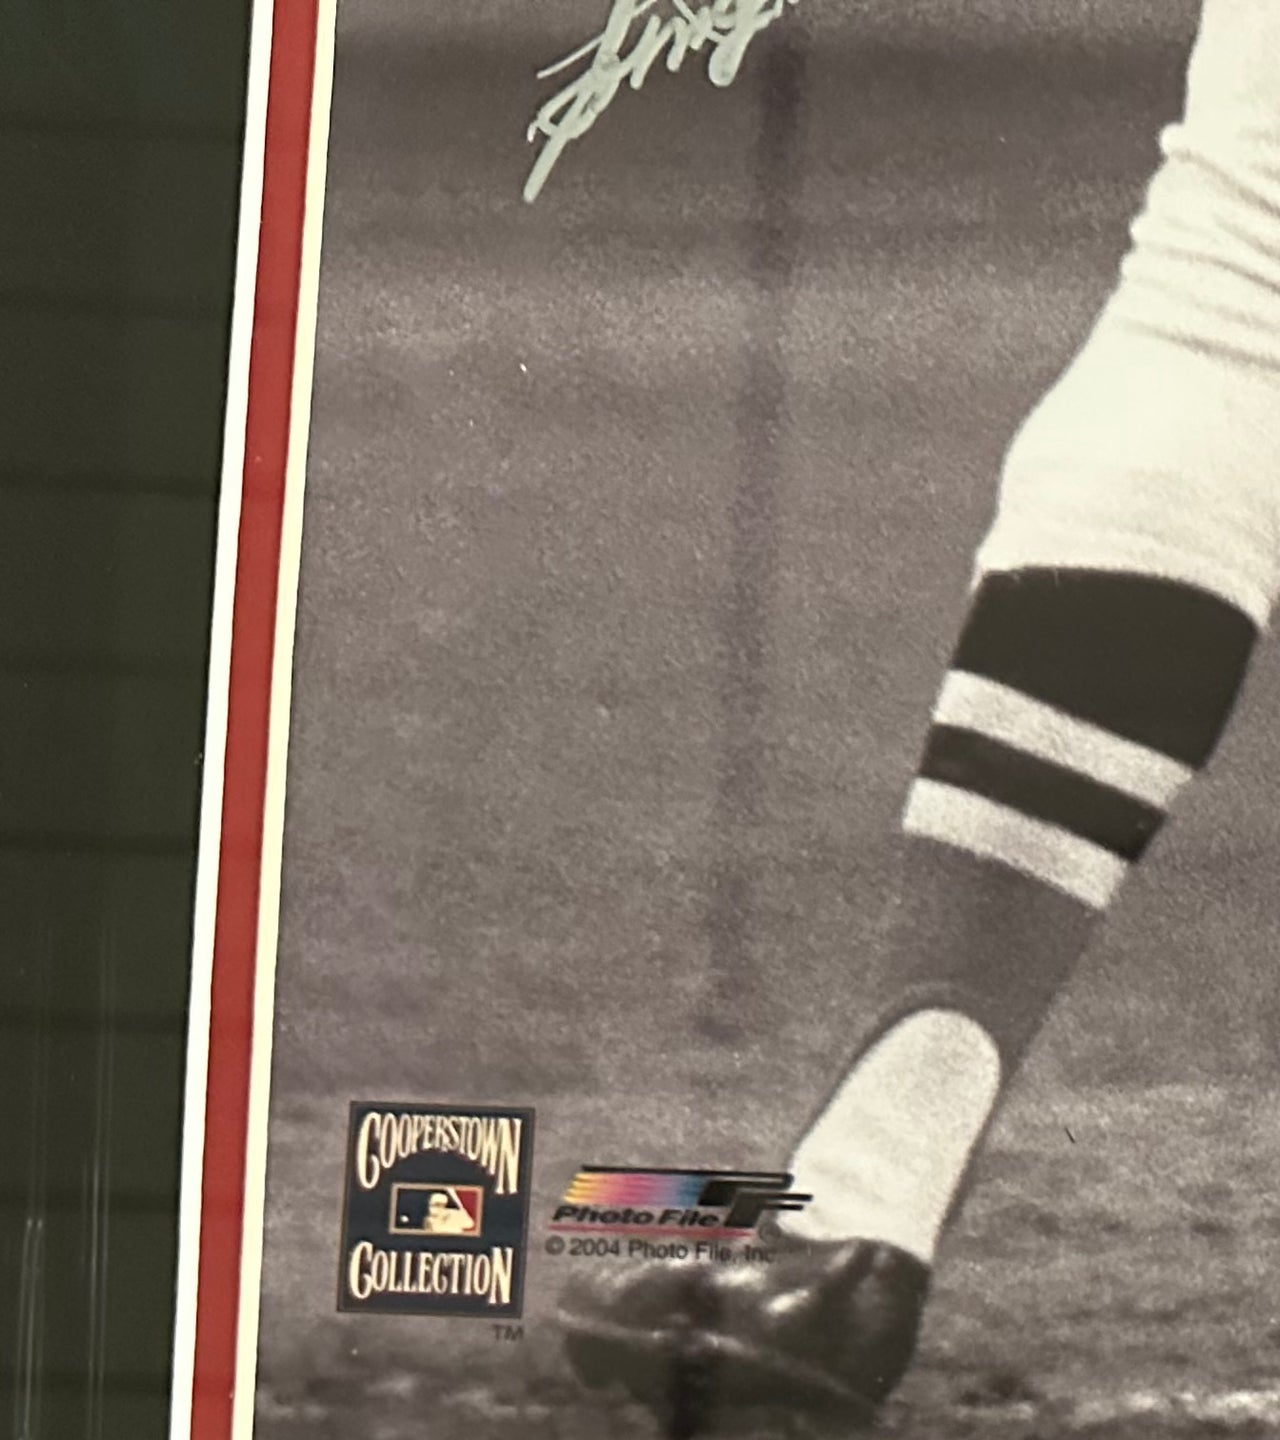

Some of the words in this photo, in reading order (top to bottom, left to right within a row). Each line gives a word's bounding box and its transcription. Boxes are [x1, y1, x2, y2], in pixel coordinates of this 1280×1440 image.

[356, 1111, 523, 1196] COOPERSTOWN
[552, 1205, 655, 1226] Photo
[657, 1208, 720, 1228] File
[568, 1236, 621, 1257] 2004
[627, 1240, 689, 1261] Photo
[348, 1240, 514, 1306] COLLECTION
